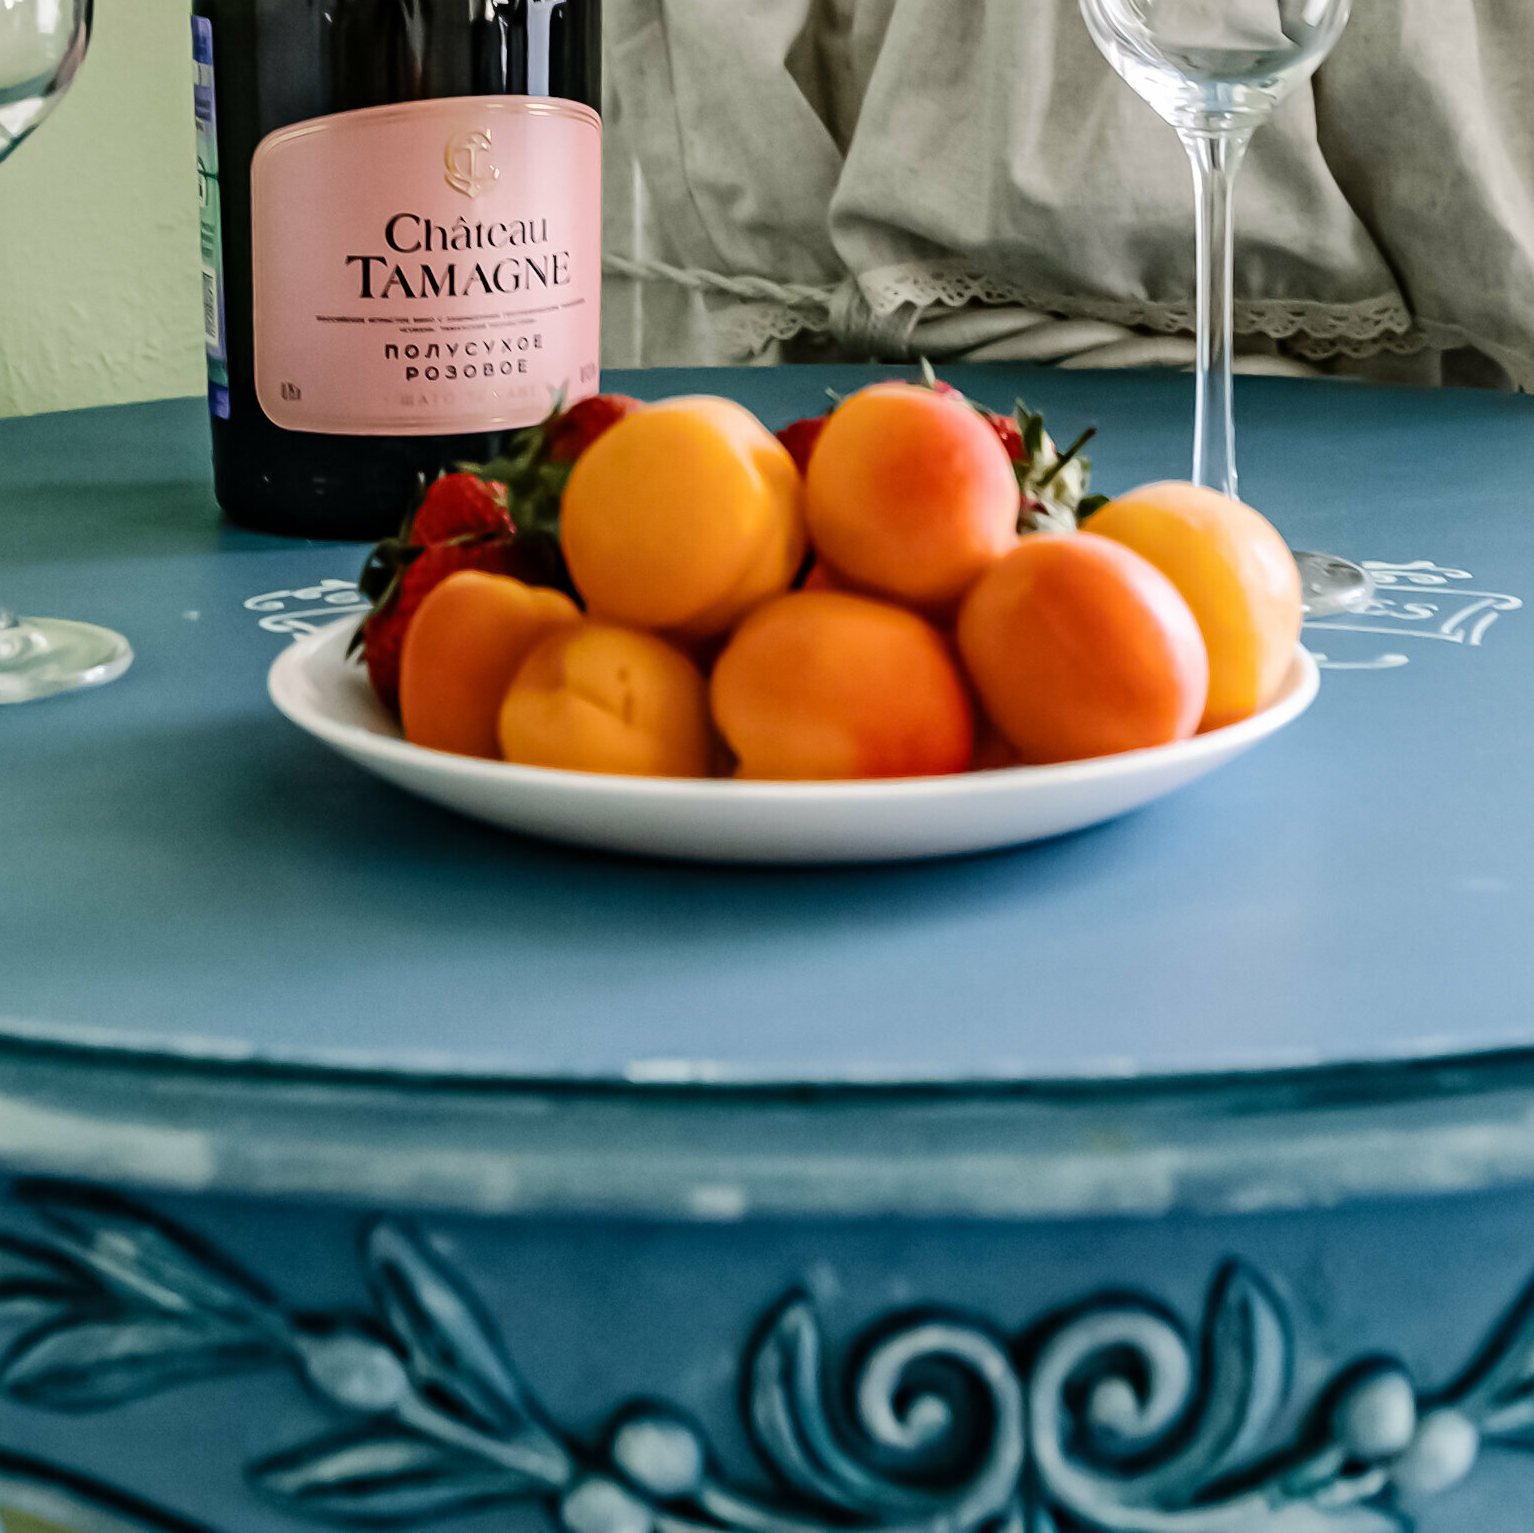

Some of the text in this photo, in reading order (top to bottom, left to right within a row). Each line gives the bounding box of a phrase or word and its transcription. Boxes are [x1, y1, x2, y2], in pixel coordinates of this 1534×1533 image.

[384, 212, 549, 254] Château
[345, 251, 572, 299] TAMAGNE
[385, 334, 543, 360] ПОЛУСУХОЕ
[406, 359, 528, 382] РОЗОВОЕ
